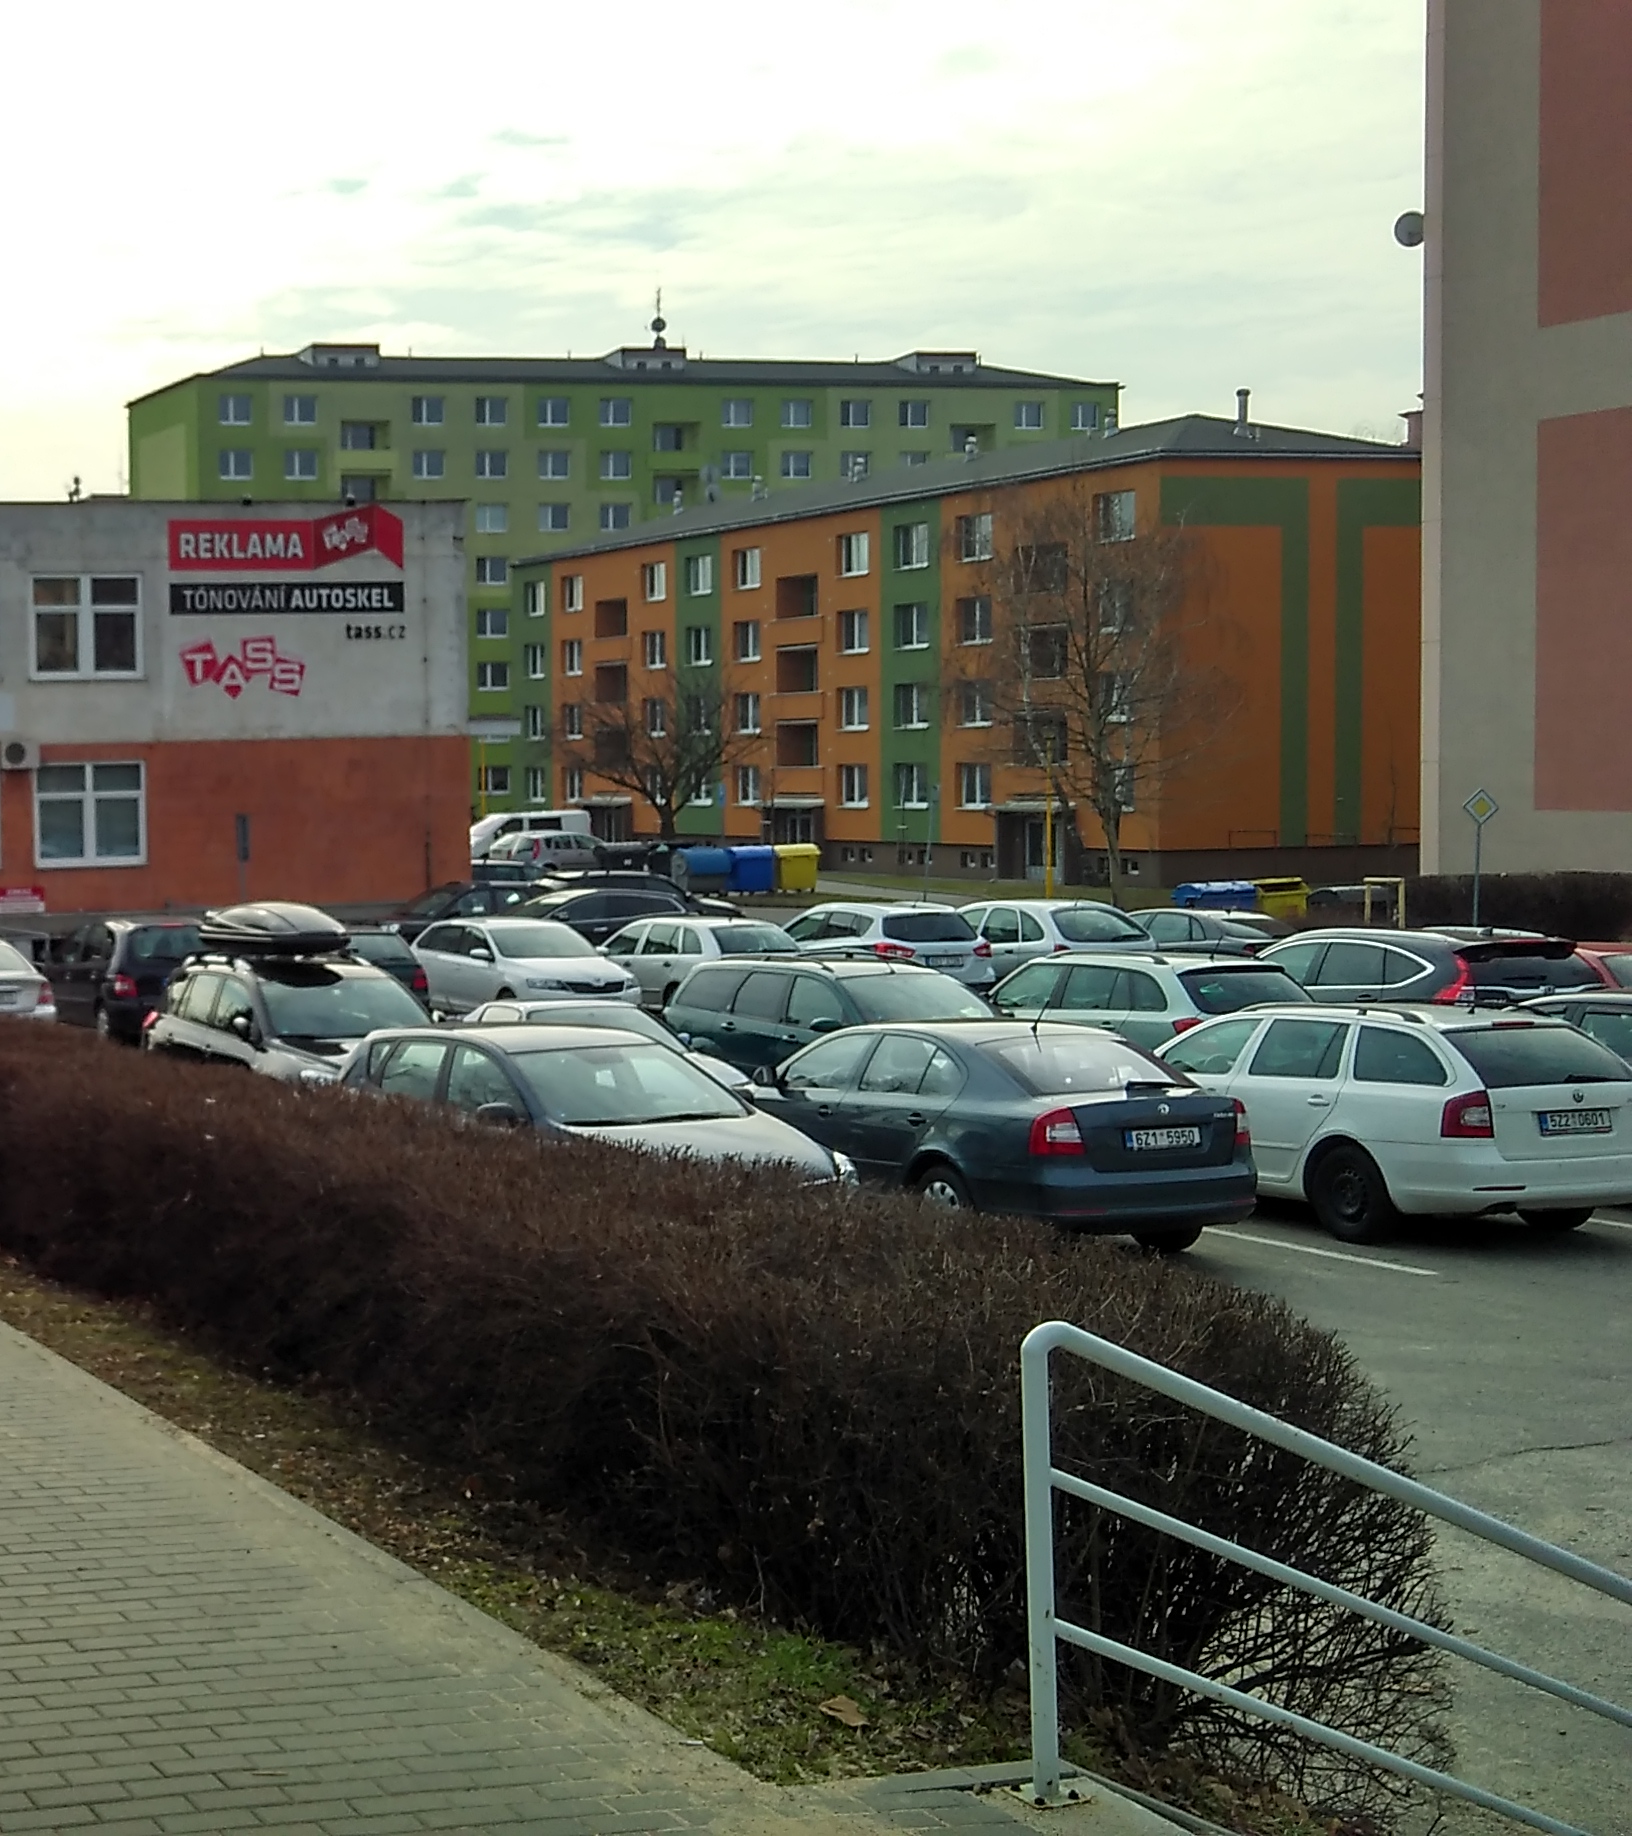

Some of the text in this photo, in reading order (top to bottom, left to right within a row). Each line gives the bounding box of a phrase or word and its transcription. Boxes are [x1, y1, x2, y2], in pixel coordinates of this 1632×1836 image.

[179, 532, 304, 559] REKLAMA
[182, 585, 394, 610] TÓNOVÁNÍ AUTOSKEL
[346, 623, 406, 640] tass.cz
[182, 638, 303, 693] TASS
